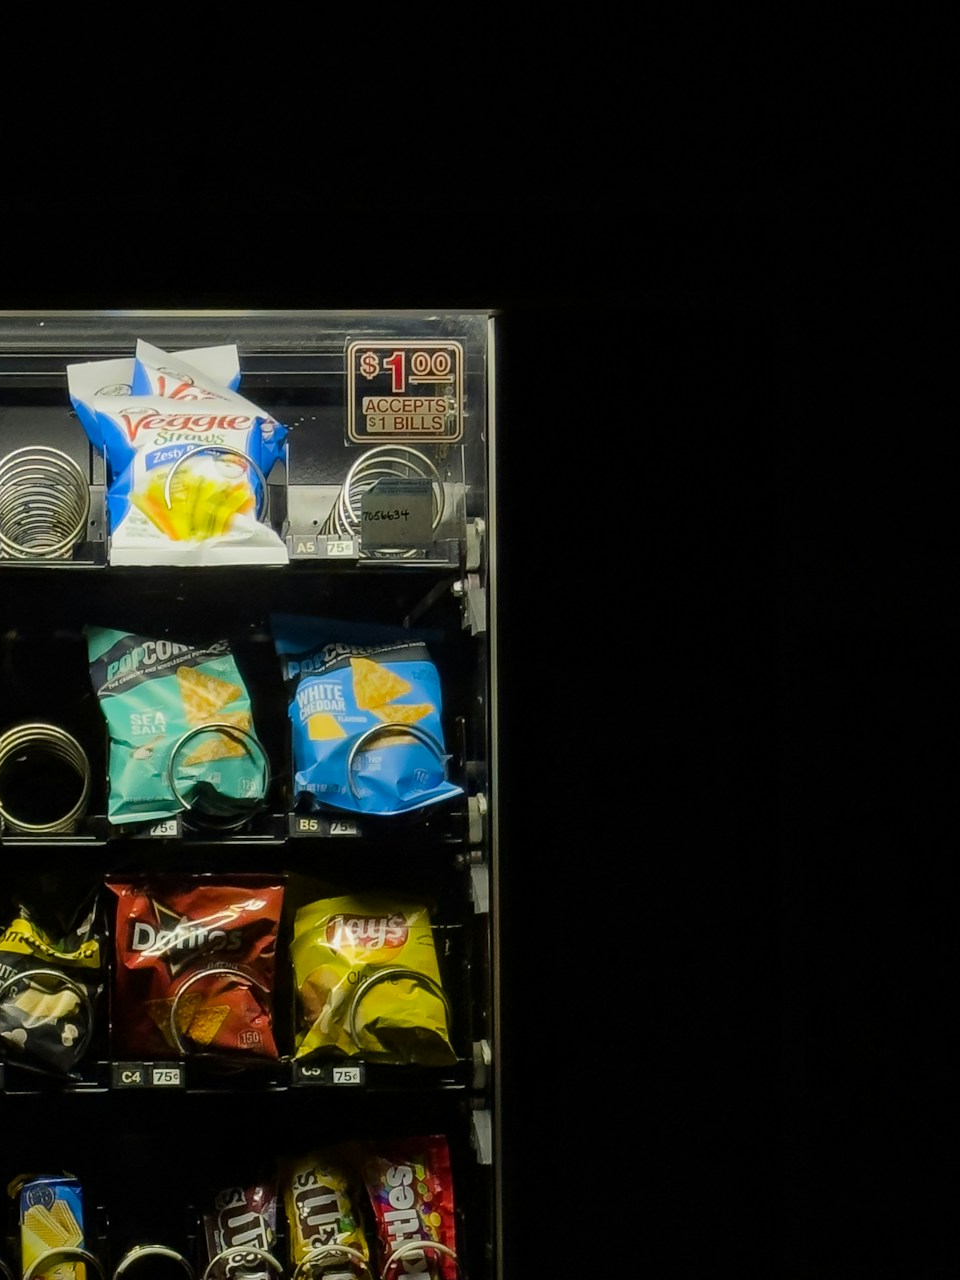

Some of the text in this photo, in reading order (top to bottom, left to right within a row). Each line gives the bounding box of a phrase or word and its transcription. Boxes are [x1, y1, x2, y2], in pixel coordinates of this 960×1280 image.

[365, 398, 447, 413] ACCEPTS
[122, 413, 252, 442] Veggie
[368, 416, 444, 430] $1 BILLS
[153, 431, 225, 446] Straws
[152, 448, 184, 464] Zesty
[363, 508, 410, 521] 7056634
[296, 542, 315, 553] A5
[297, 683, 344, 709] WHITE
[299, 699, 346, 721] CHEDDAR
[130, 711, 167, 726] SEA
[130, 723, 167, 735] SALT
[299, 819, 318, 831] B5
[132, 918, 243, 951] Doritos
[121, 1071, 141, 1083] C4
